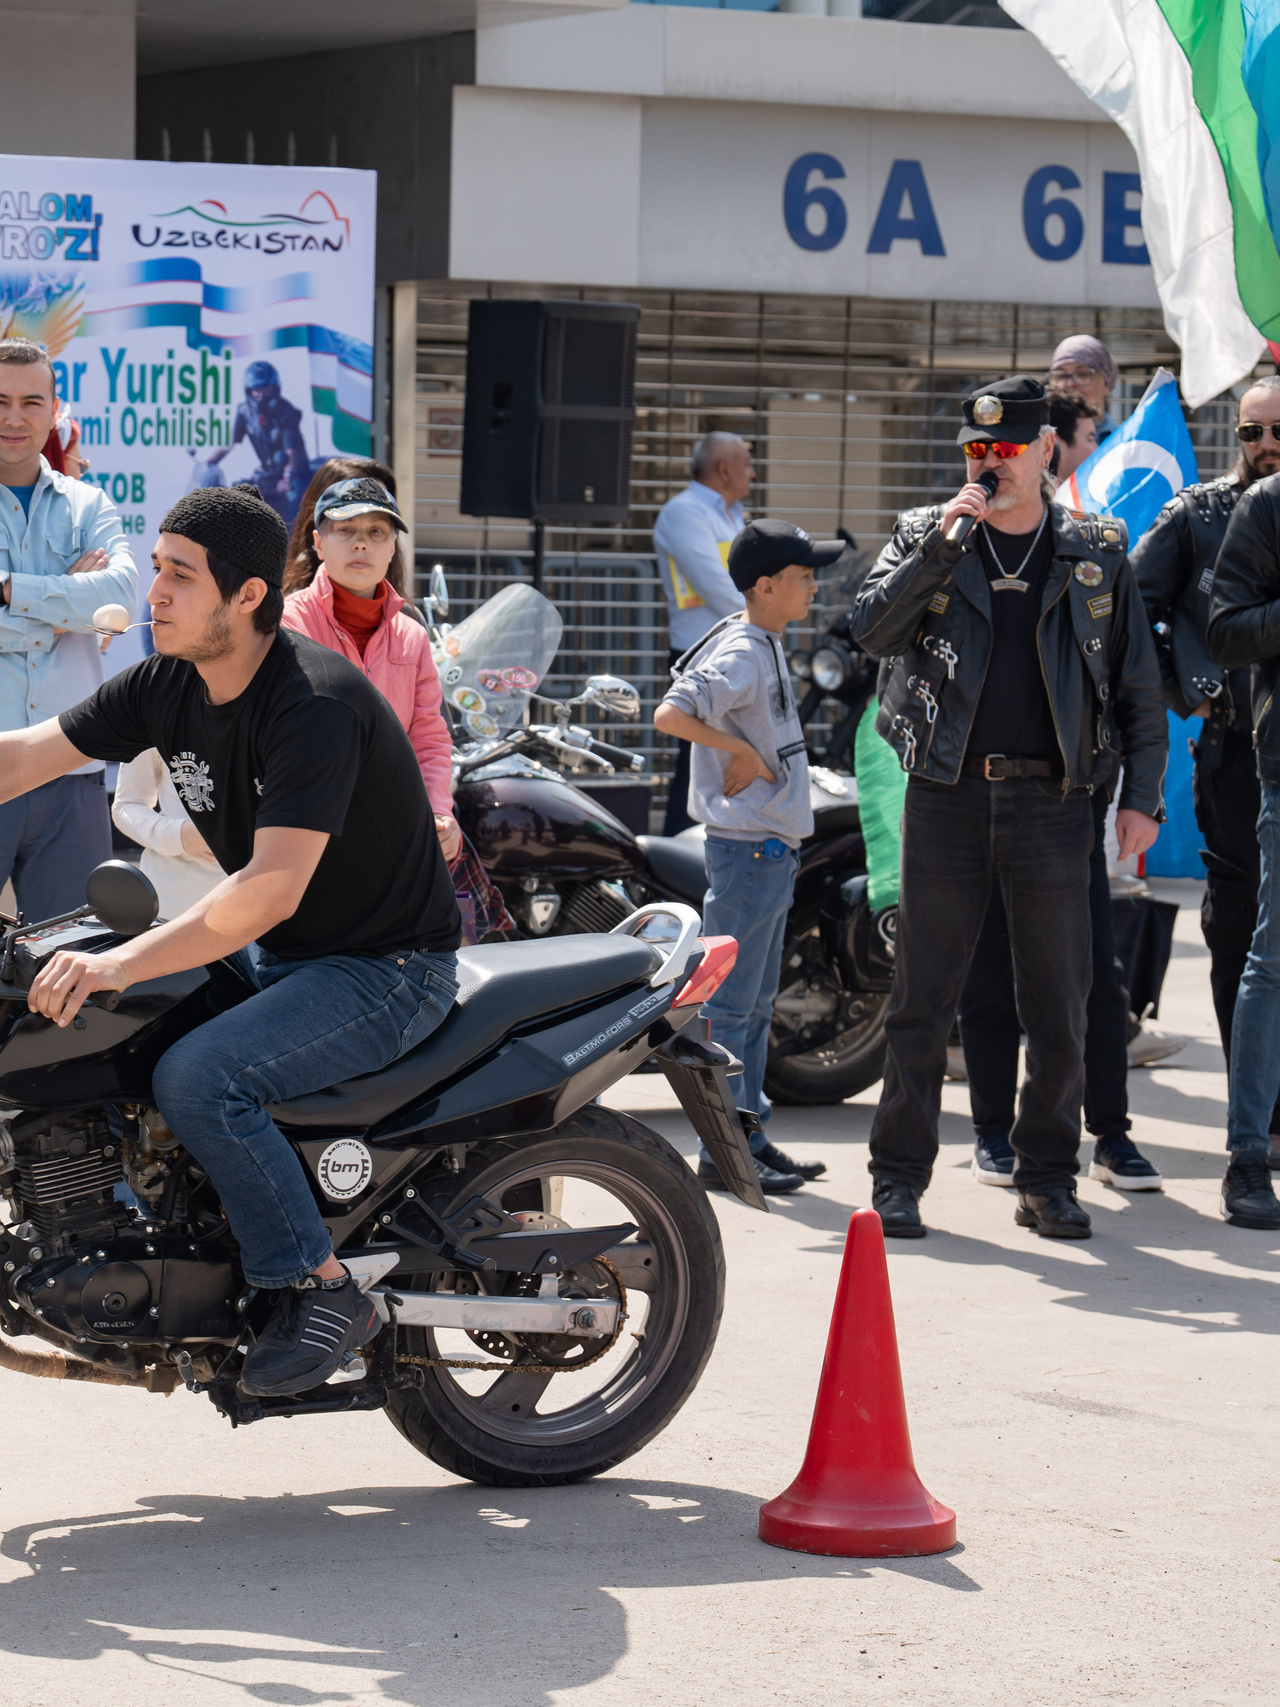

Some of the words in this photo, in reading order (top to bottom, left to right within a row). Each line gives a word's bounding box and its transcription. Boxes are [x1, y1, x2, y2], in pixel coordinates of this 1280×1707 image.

[783, 152, 947, 257] 6A
[132, 224, 344, 255] UZBEKISTAN
[100, 347, 232, 404] Yurishi
[121, 407, 231, 447] Ochilishi
[562, 1015, 634, 1067] BALTMOTORS
[331, 1161, 360, 1173] bm
